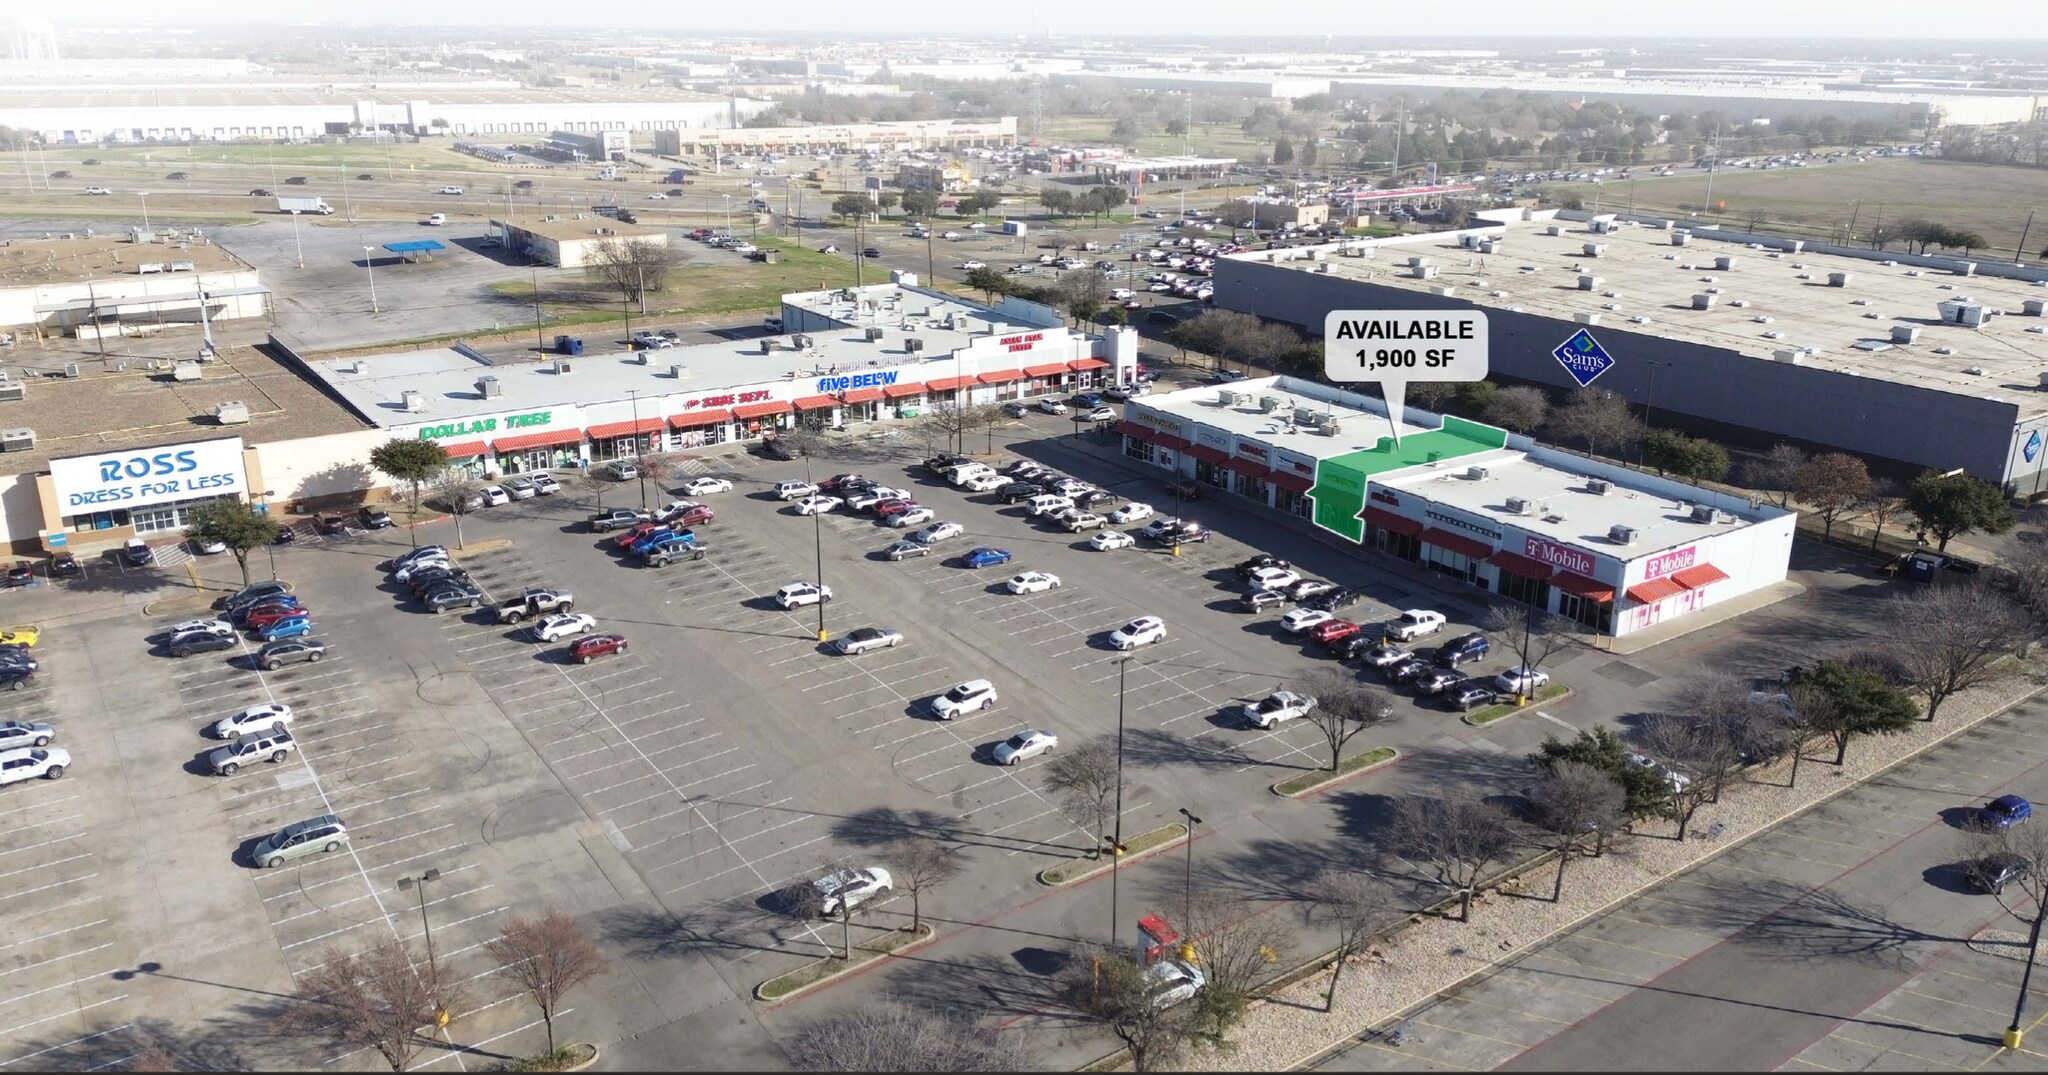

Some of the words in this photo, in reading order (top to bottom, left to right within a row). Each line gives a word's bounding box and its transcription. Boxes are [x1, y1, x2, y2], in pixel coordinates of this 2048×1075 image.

[818, 376, 850, 392] five
[851, 370, 898, 388] BELOW
[419, 418, 497, 441] DOLLAR
[504, 411, 552, 429] TREE
[99, 450, 197, 482] ROSS
[69, 487, 134, 506] DRESS
[141, 480, 180, 496] FOR
[187, 473, 235, 490] LESS
[1541, 544, 1590, 573] Mobile
[1659, 550, 1694, 575] Mobile
